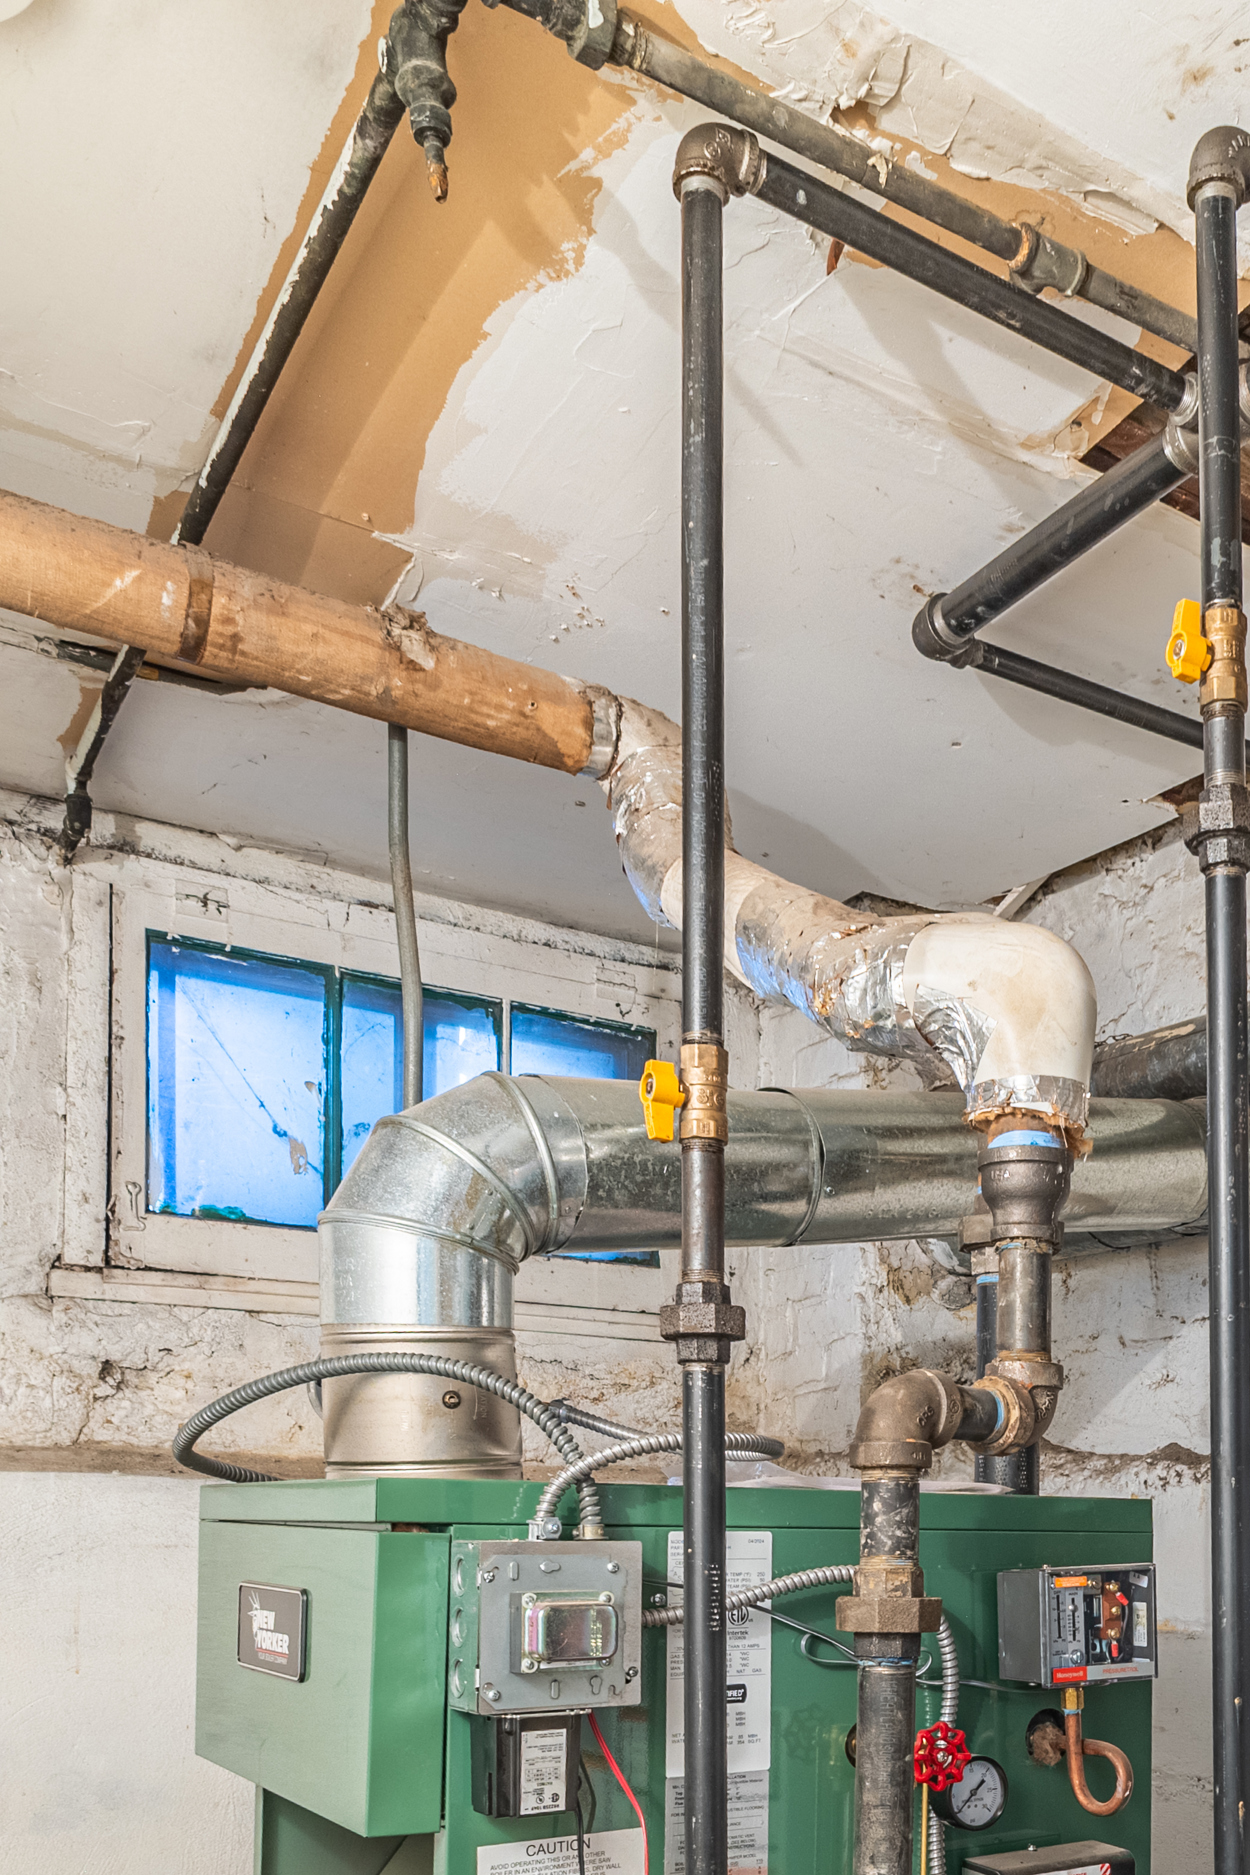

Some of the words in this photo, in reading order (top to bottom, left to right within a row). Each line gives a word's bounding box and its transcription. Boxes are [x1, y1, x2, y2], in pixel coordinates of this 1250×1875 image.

[257, 1610, 275, 1630] NEW
[257, 1630, 289, 1654] YORKER
[490, 1863, 509, 1871] AVOID
[511, 1859, 545, 1868] OPERATING
[532, 1862, 574, 1873] ENVIRONMENT
